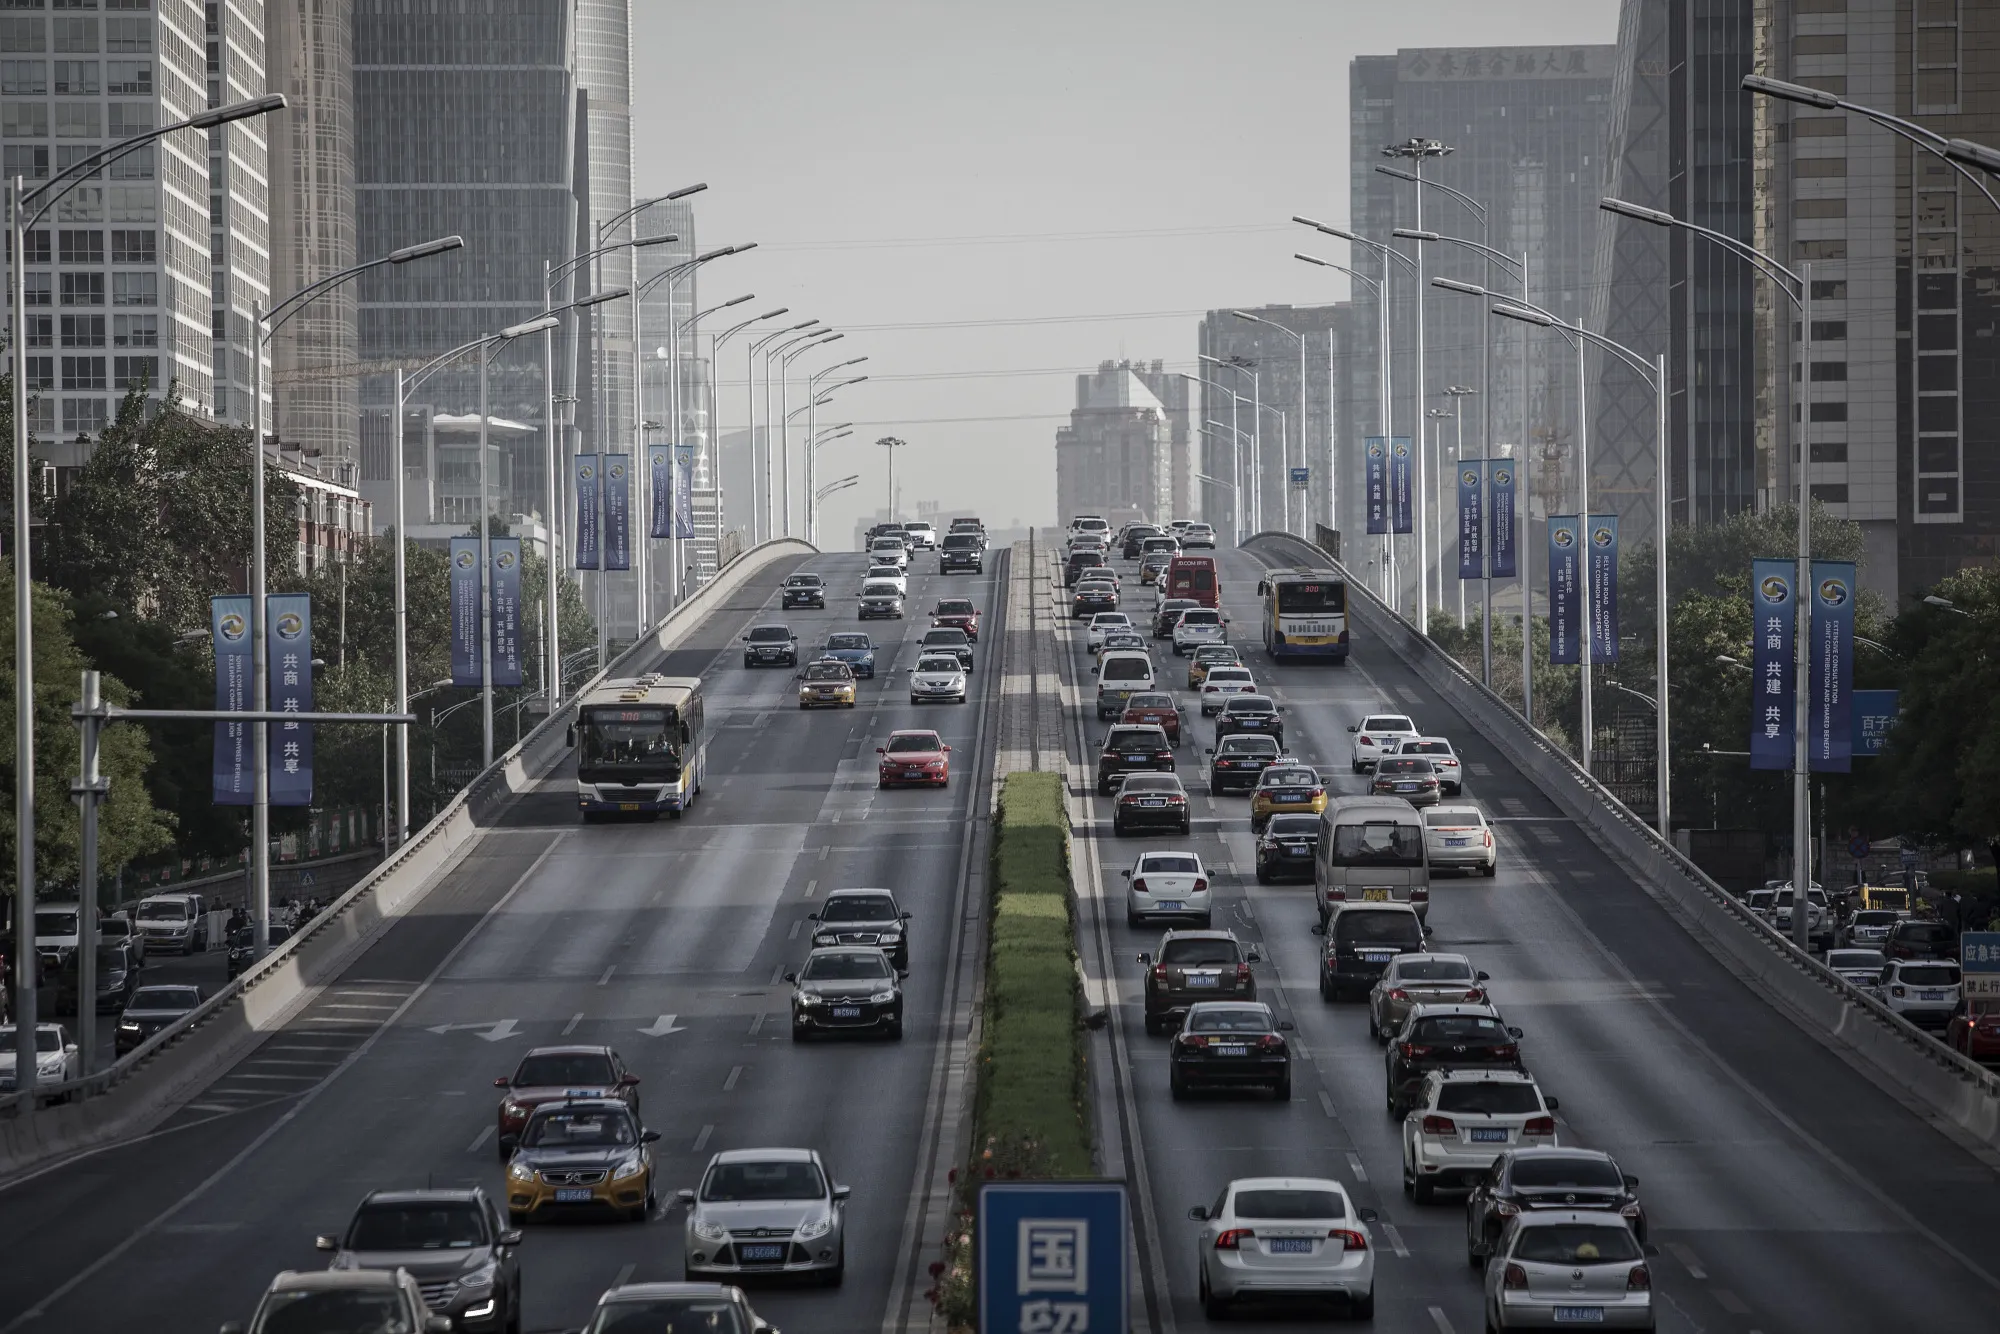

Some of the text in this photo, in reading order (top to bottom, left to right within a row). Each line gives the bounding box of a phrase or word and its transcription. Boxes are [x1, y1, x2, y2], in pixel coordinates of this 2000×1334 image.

[1603, 610, 1611, 656] COOPERATION
[1764, 617, 1782, 739] 共商 共建 共享
[1965, 944, 2000, 962] 应急车
[1967, 980, 2000, 993] 禁止行
